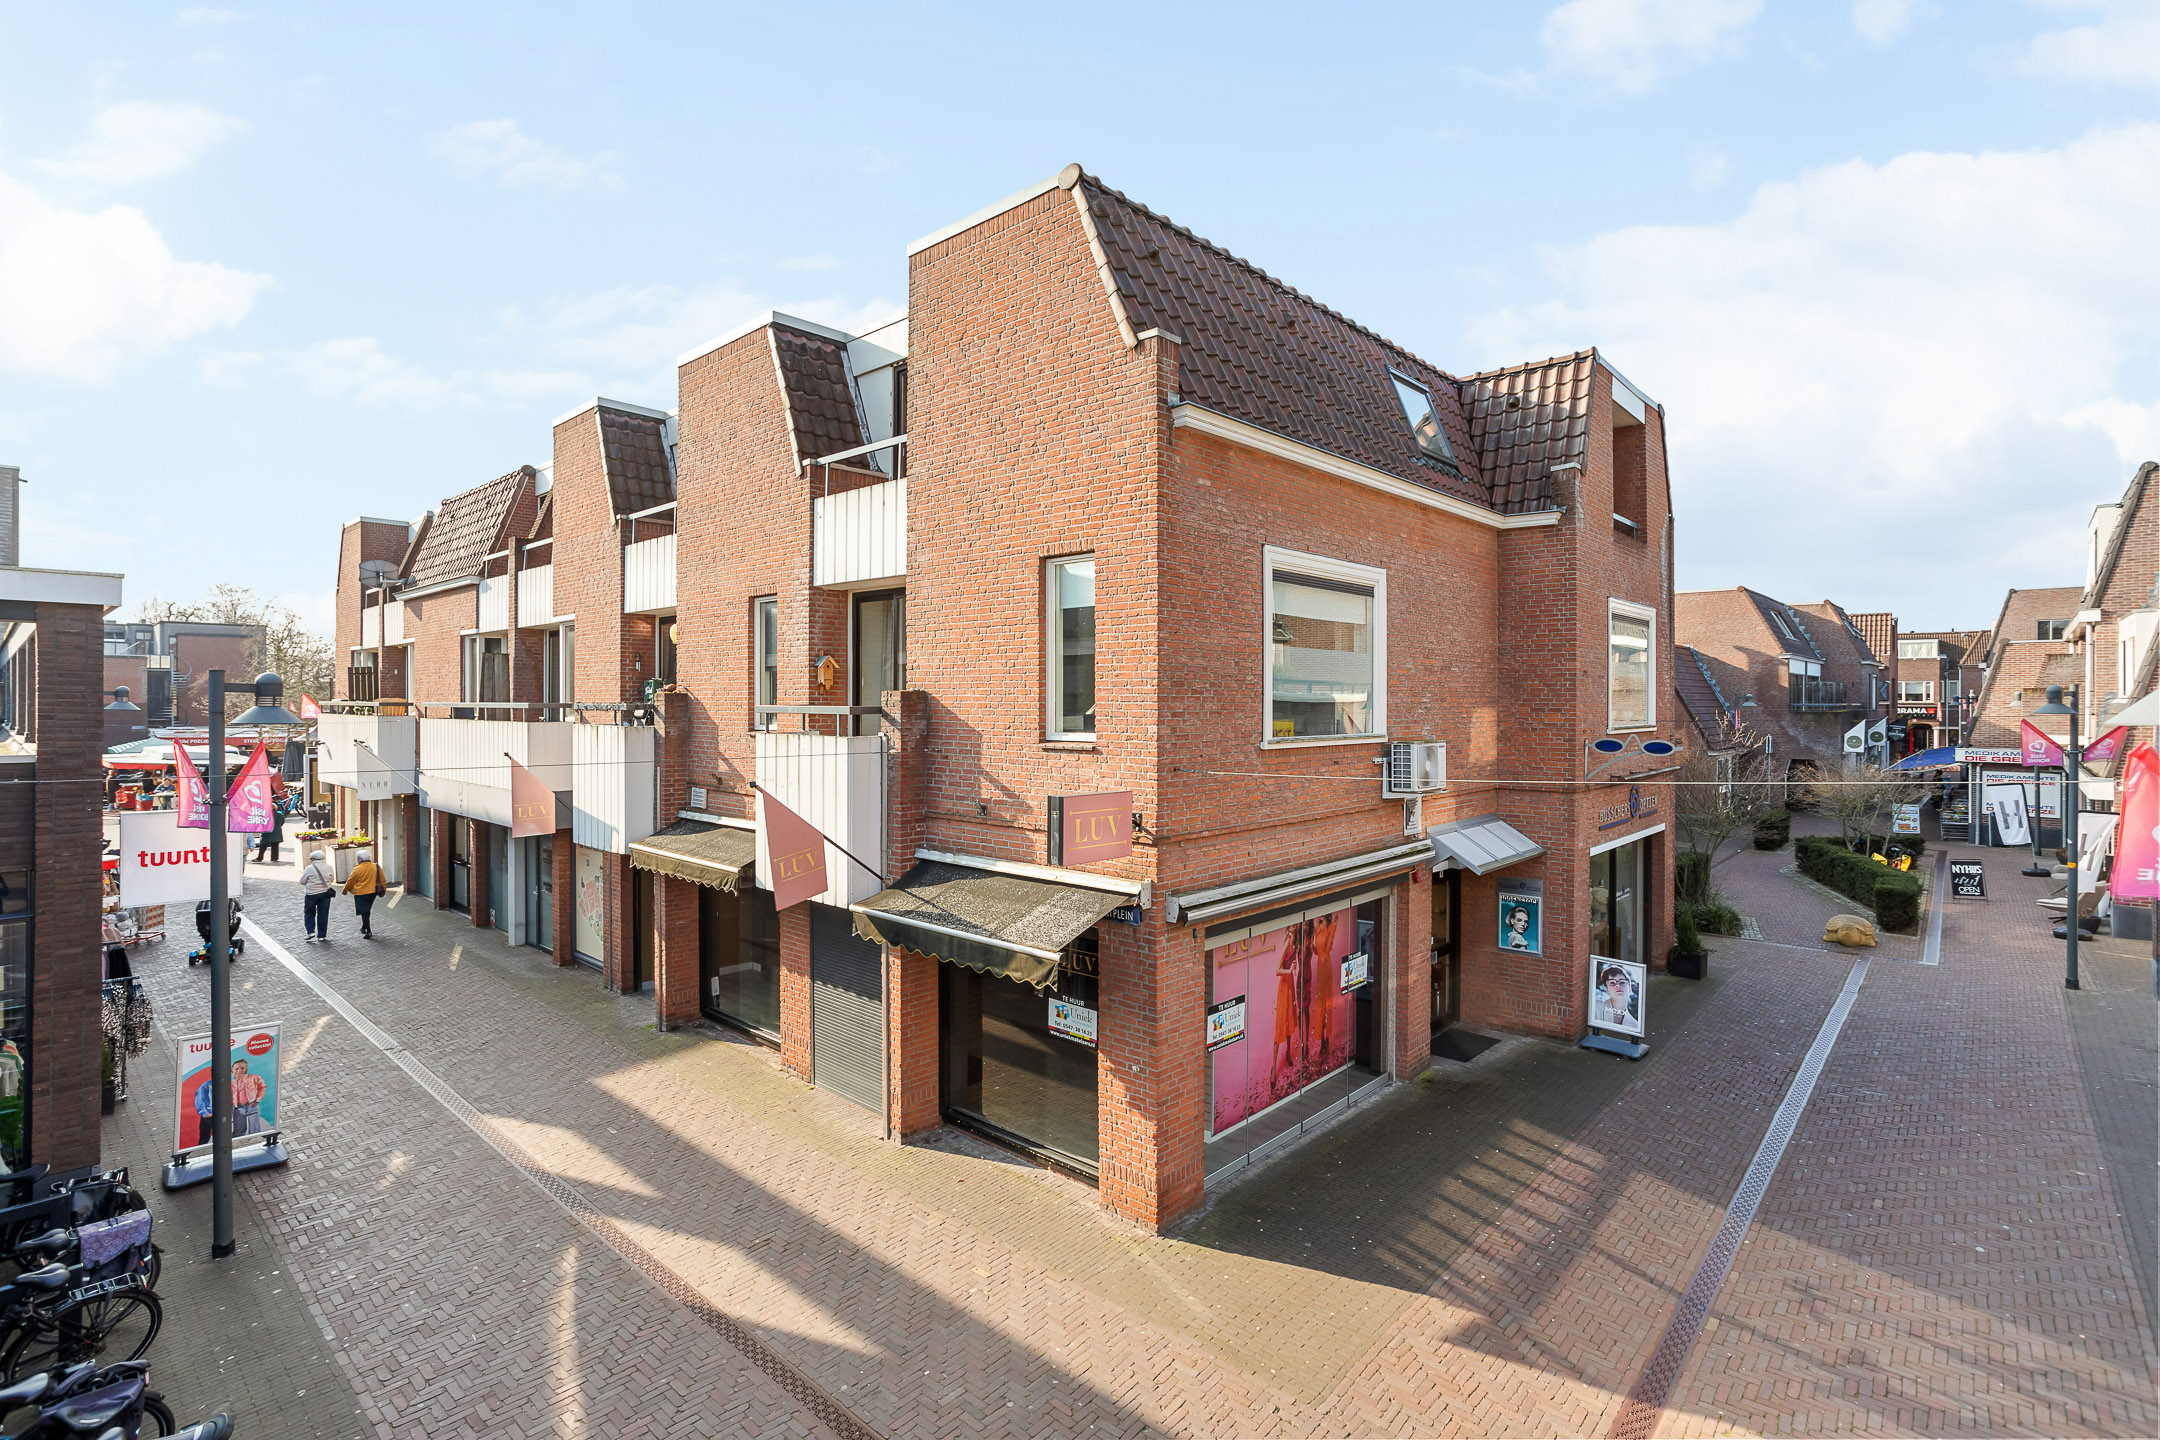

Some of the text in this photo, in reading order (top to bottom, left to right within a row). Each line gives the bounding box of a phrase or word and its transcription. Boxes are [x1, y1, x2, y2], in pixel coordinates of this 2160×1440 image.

[518, 805, 552, 819] LUV
[1074, 814, 1122, 843] LUV
[138, 846, 209, 867] tuunt
[779, 851, 817, 878] LUV
[1951, 864, 1982, 874] NYHUS
[1070, 997, 1085, 1007] HUUR
[1071, 1007, 1093, 1024] Uniek
[189, 1038, 236, 1054] tuue
